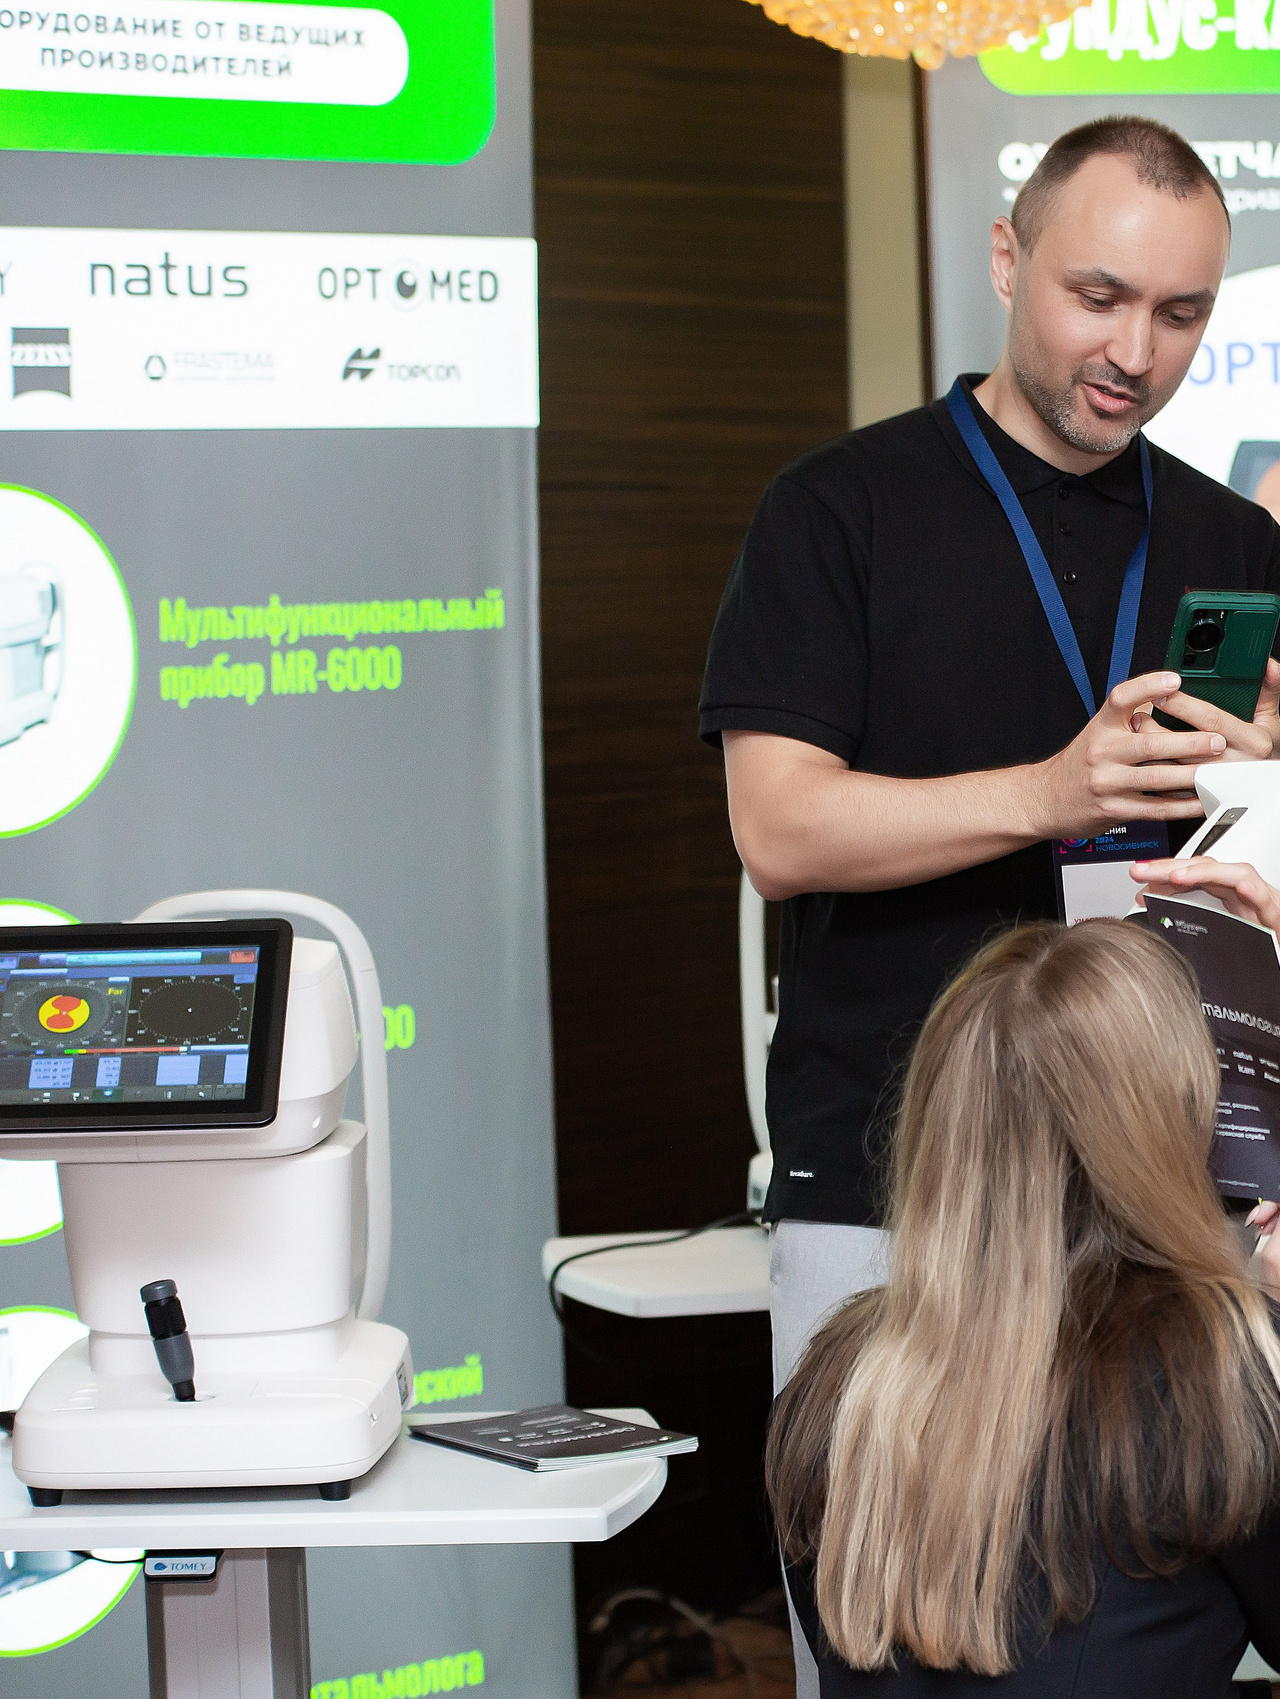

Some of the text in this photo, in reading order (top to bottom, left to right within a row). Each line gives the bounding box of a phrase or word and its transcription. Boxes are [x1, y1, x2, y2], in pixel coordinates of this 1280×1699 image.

[194, 21, 226, 40] ОТ
[238, 24, 365, 47] ВЕДУЩИХ
[40, 48, 292, 78] ПРОИЗВОДИТЕЛЕЙ
[89, 251, 249, 298] natus
[159, 588, 505, 647] Мультифункциональный
[160, 645, 402, 708] прибор MR-6000
[1095, 836, 1114, 844] 2024
[1096, 841, 1159, 852] НОВОСИБИРСК
[169, 1562, 207, 1572] TOMEY
[310, 1649, 485, 1699] тальмолога
